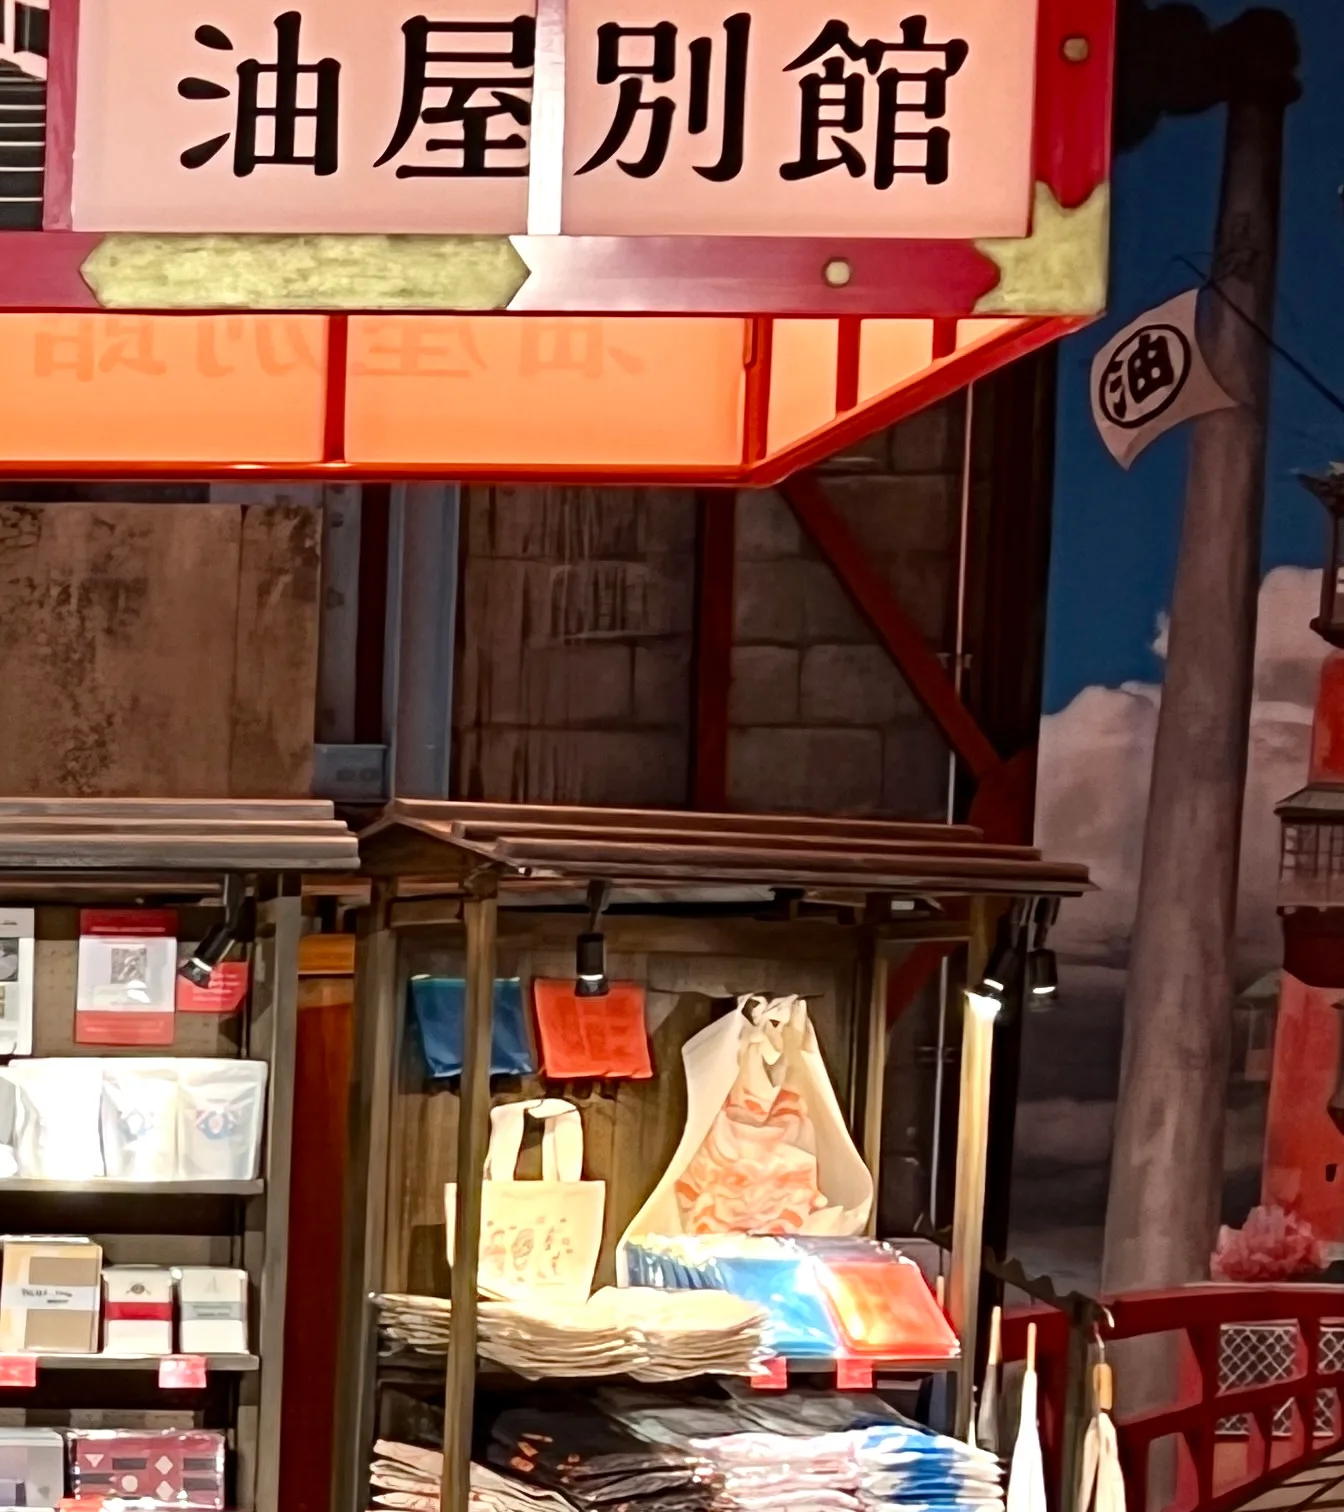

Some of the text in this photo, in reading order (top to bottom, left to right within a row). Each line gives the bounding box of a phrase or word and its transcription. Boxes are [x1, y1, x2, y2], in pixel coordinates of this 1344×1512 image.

[178, 12, 969, 190] 油屋別館
[1109, 333, 1175, 418] 油
